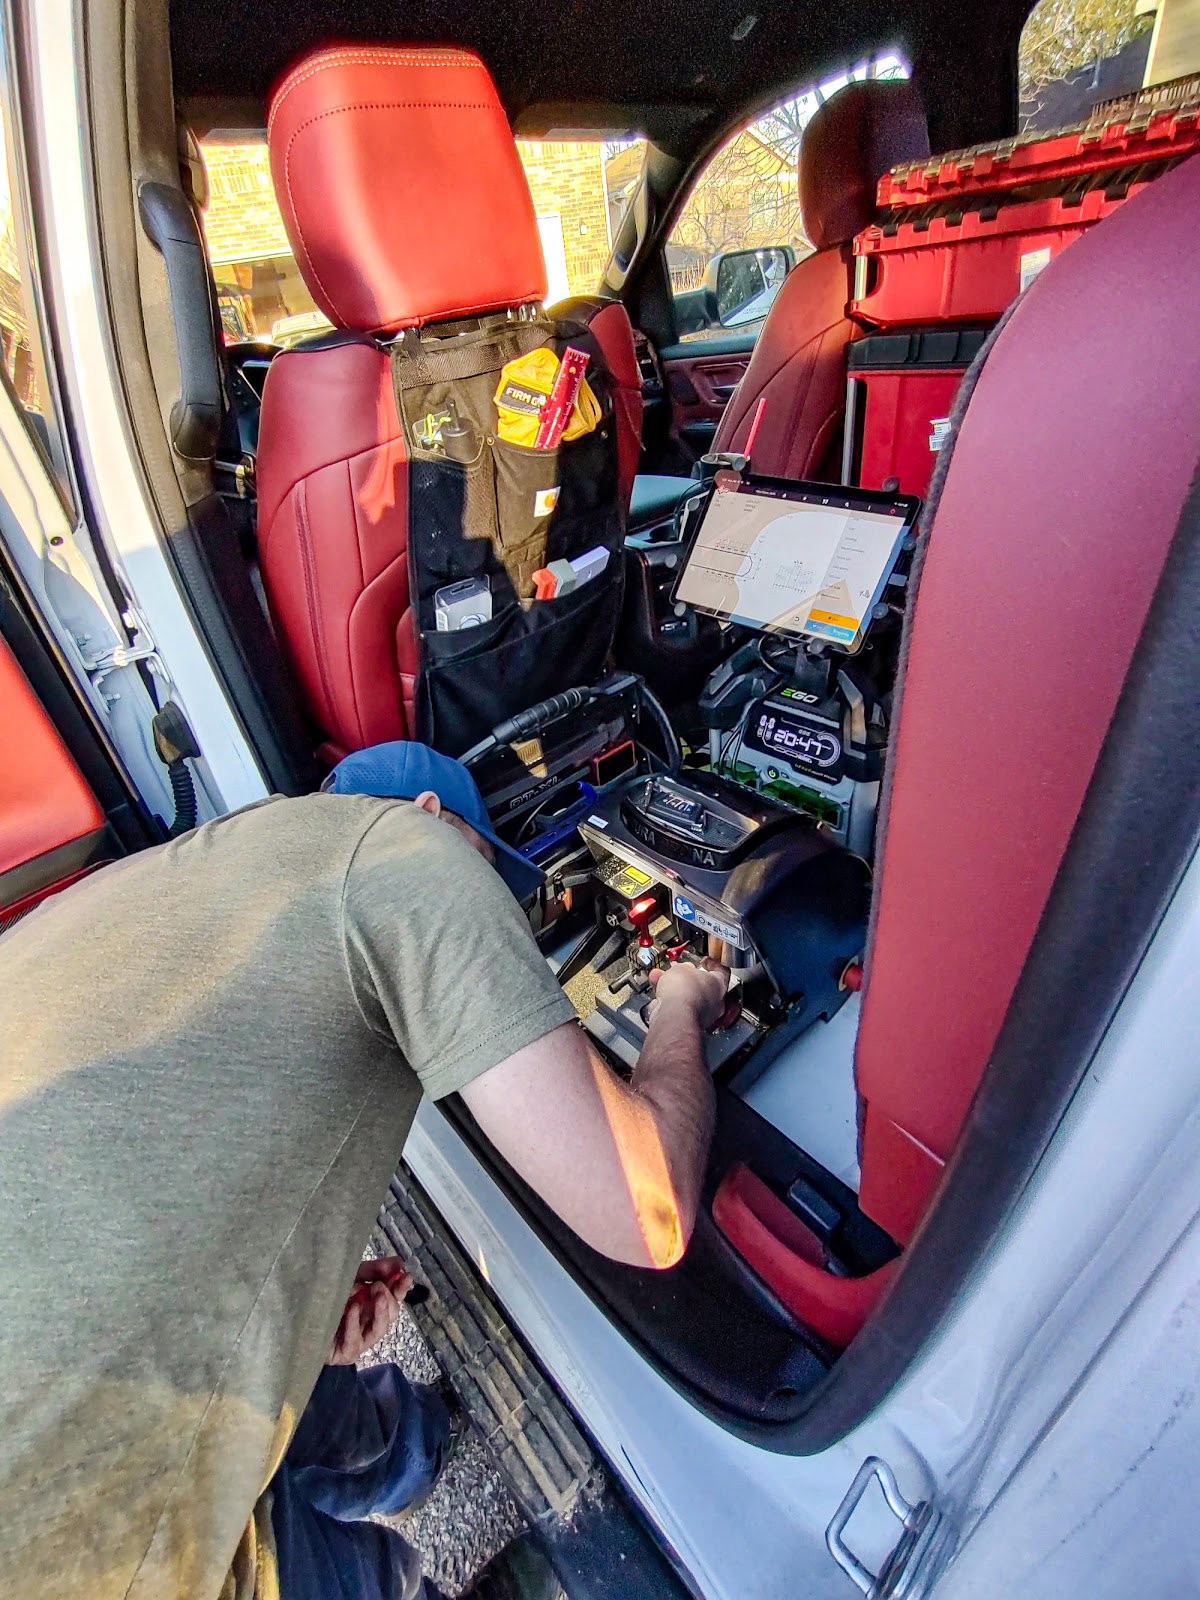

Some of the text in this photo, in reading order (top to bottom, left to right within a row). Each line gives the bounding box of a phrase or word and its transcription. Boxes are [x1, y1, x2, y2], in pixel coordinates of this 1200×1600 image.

[506, 387, 532, 403] FIRM
[780, 687, 818, 703] EGO
[773, 729, 822, 756] 20:47
[692, 848, 715, 866] NA
